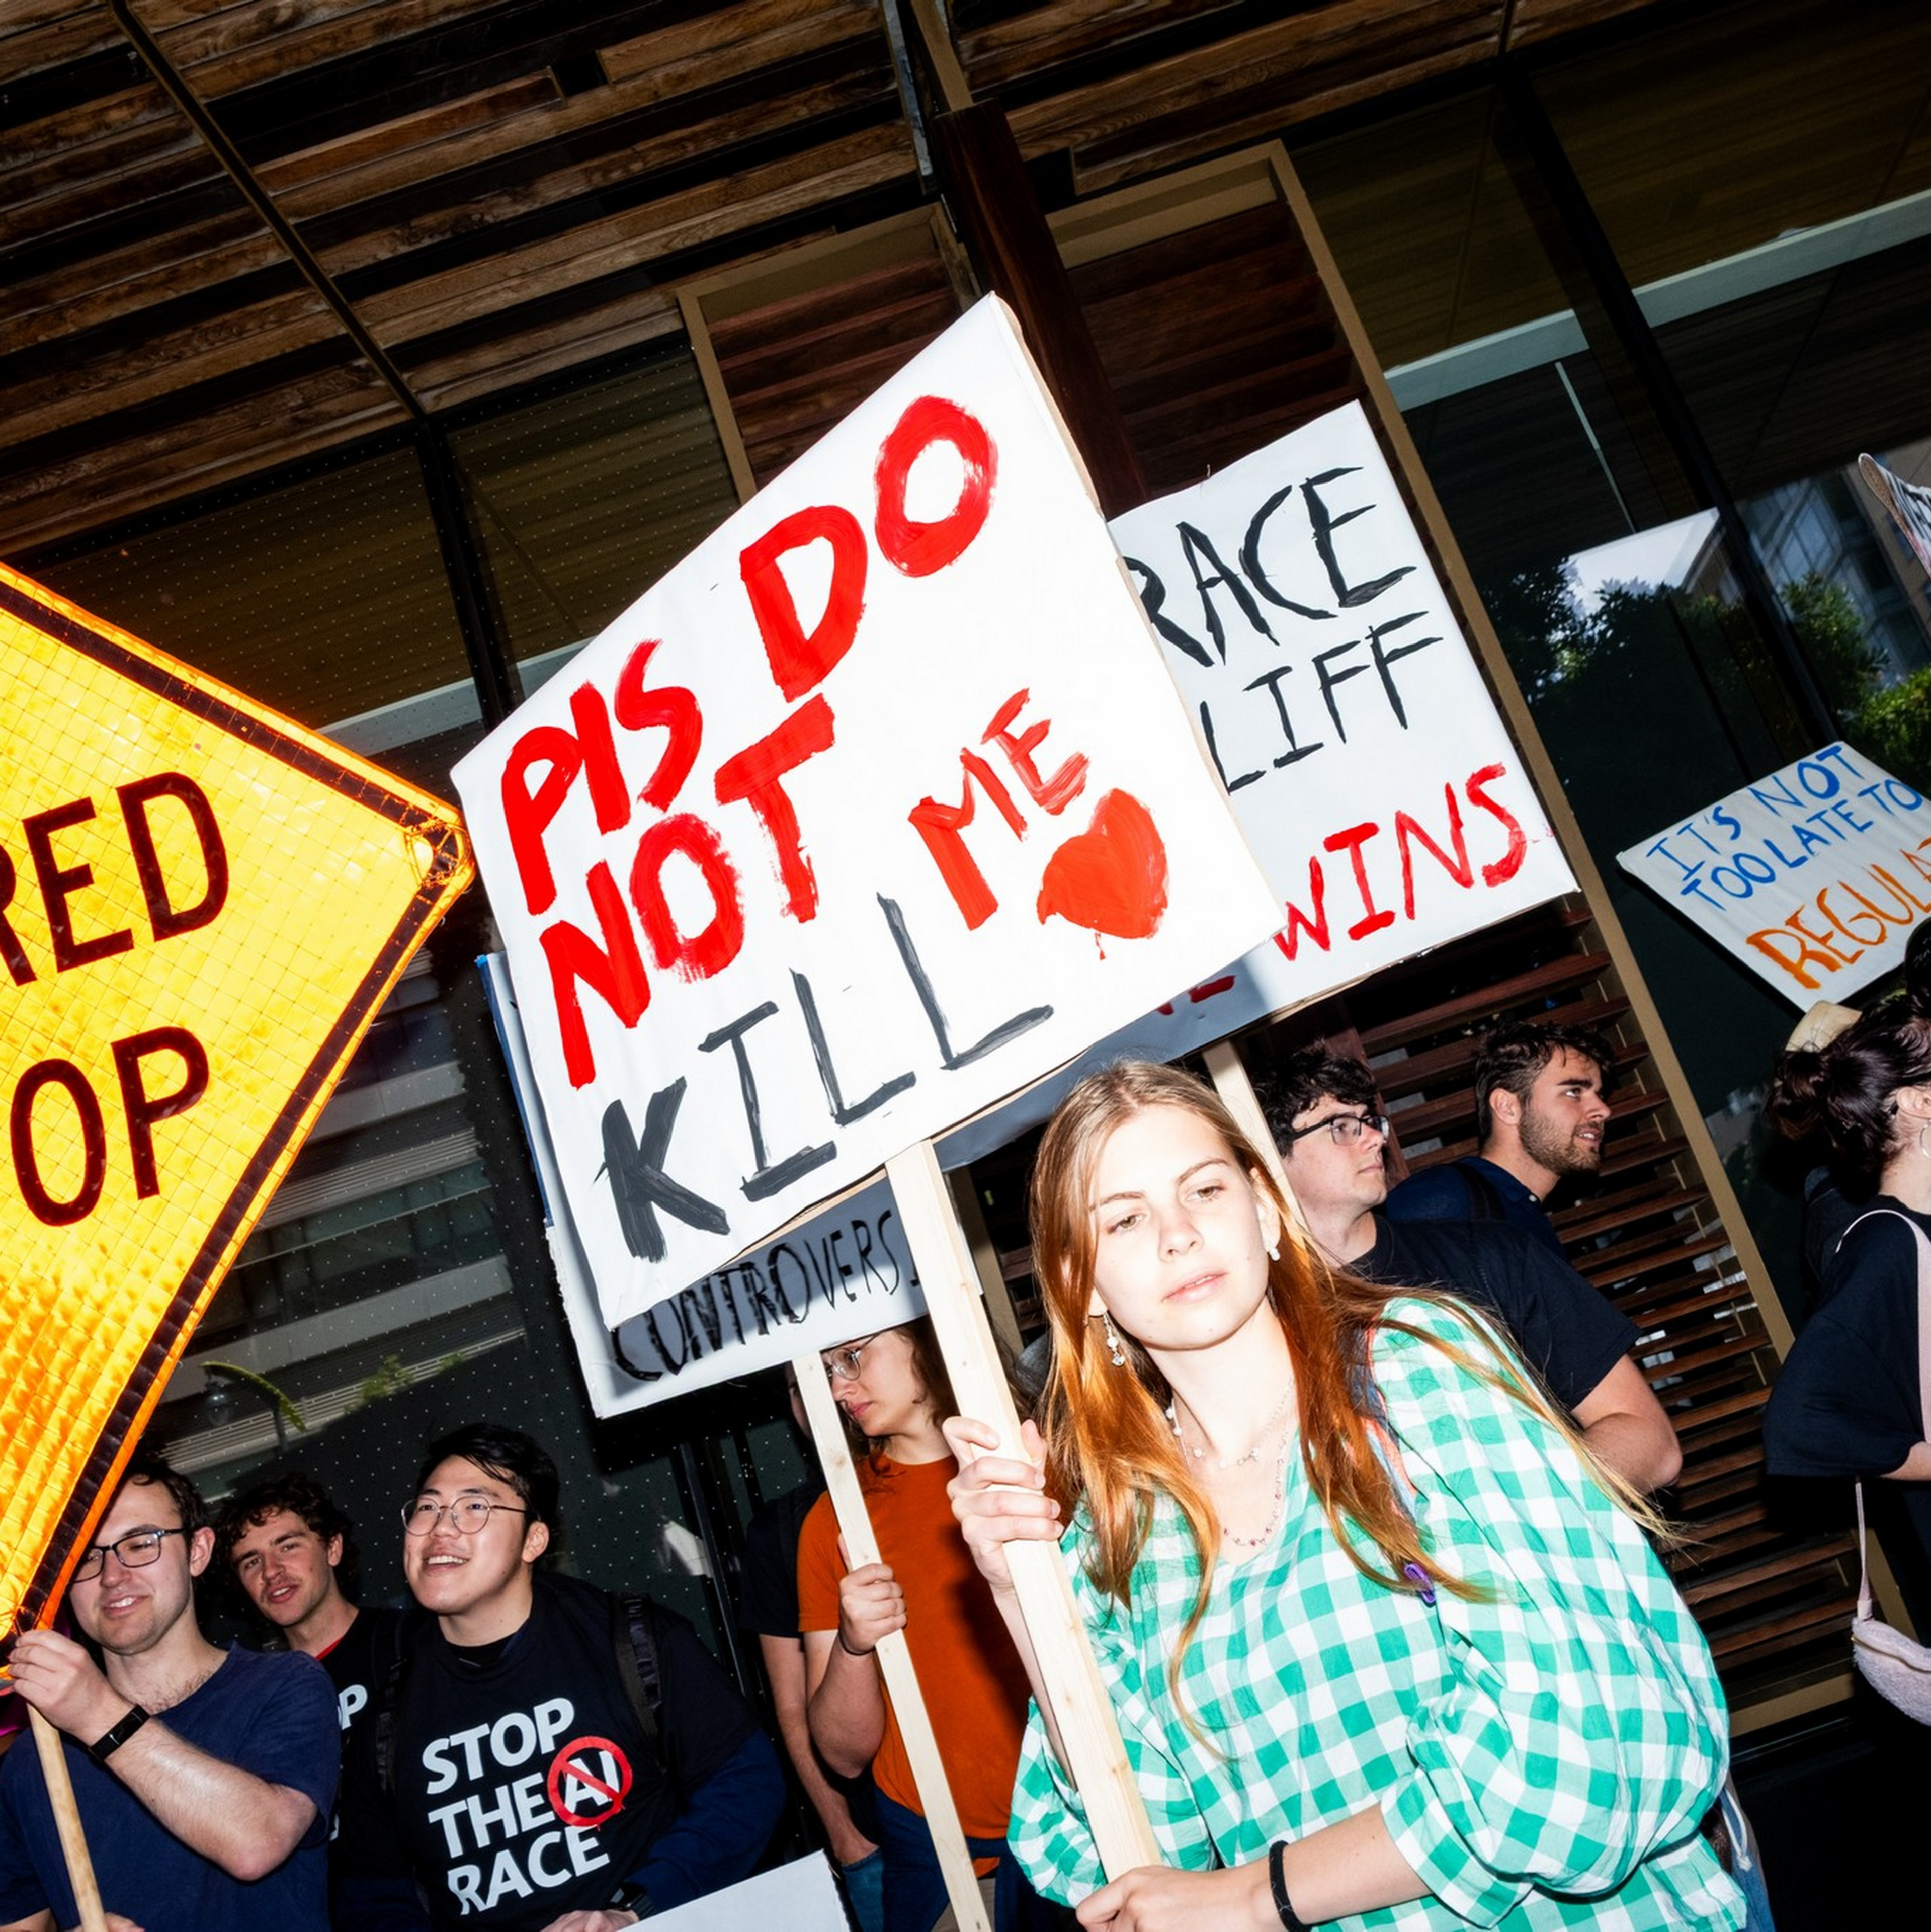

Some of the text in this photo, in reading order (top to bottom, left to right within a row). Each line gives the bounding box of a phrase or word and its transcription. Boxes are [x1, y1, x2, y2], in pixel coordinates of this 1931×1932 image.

[739, 396, 997, 703] DO
[1200, 611, 1444, 796] LIFF
[540, 693, 835, 1090] NOT
[1274, 763, 1527, 961] WINS
[1646, 746, 1864, 881] IT'S NOT
[1680, 779, 1924, 912] TOO LATE TO
[594, 688, 1090, 1263] KILL ME
[612, 1210, 920, 1381] CONTROVERS
[422, 1698, 574, 1795] STOP
[428, 1750, 620, 1859] THE AI
[448, 1824, 610, 1915] RACE
